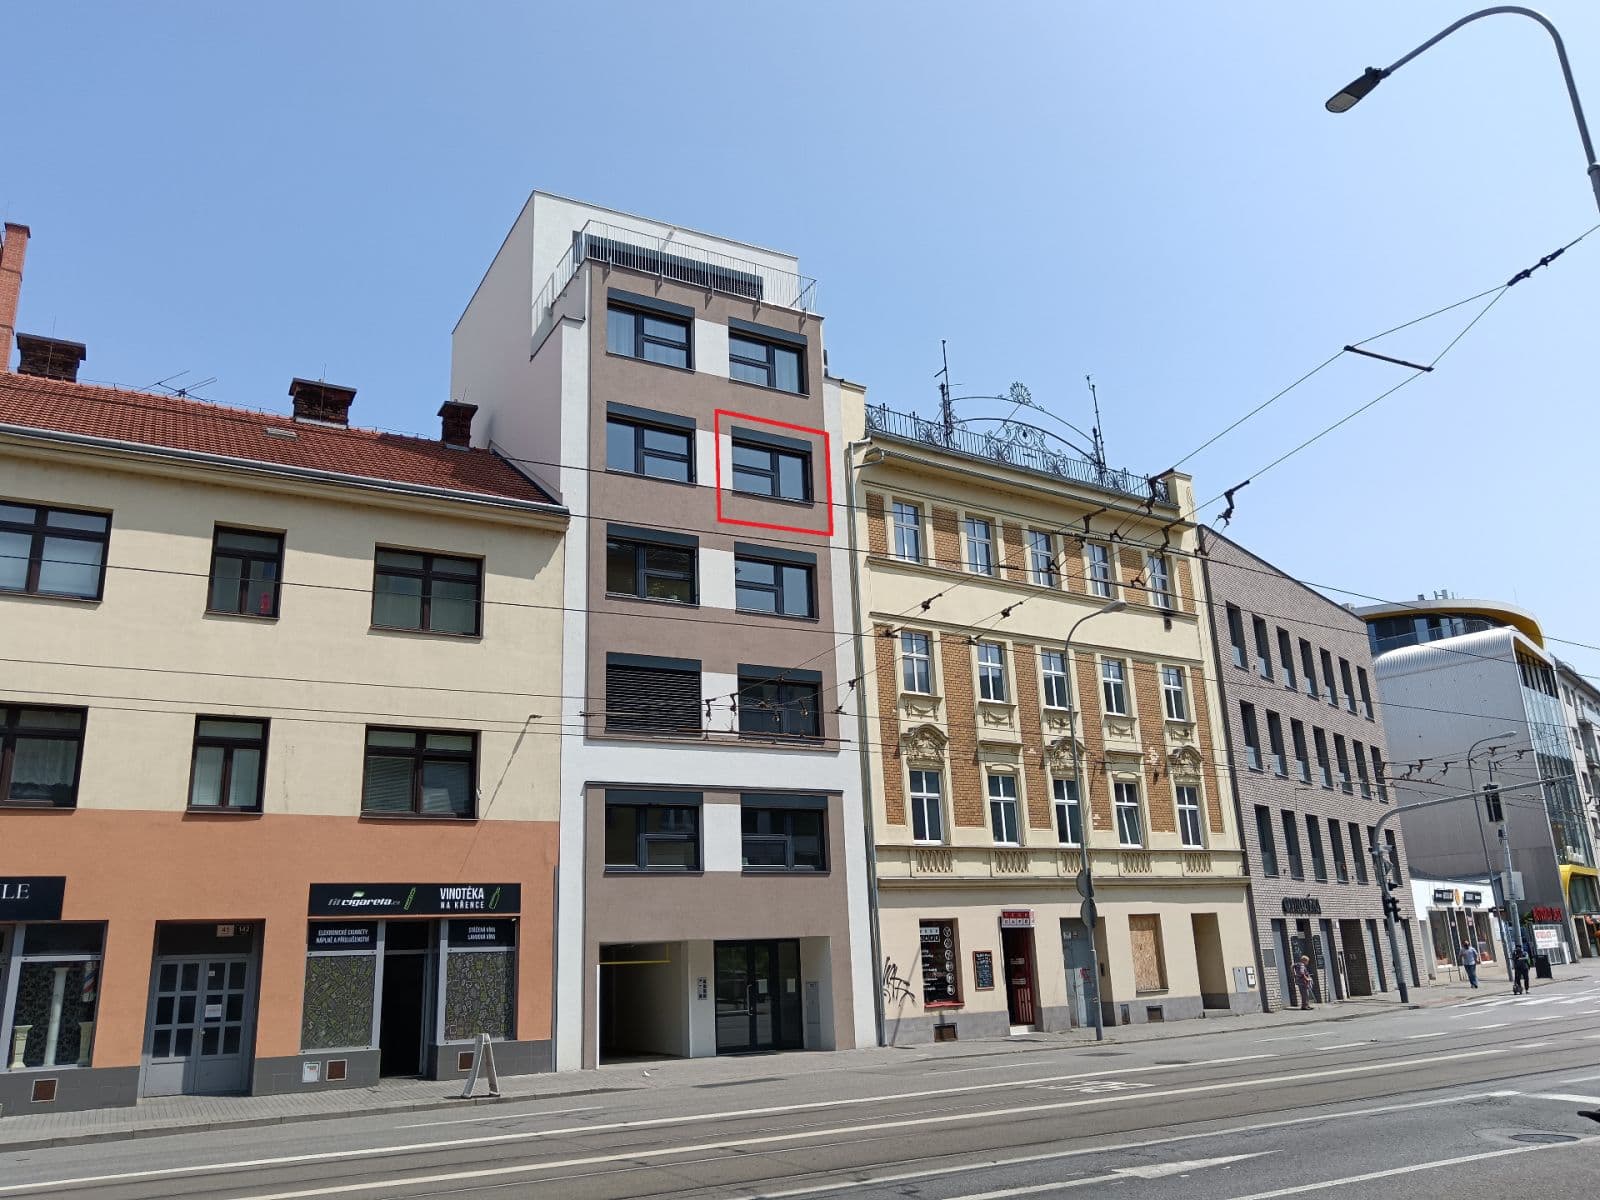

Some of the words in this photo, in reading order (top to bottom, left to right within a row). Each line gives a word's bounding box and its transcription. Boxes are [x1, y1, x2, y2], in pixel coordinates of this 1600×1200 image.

[439, 886, 485, 900] VINOTÉKA
[440, 901, 451, 909] NA
[454, 900, 485, 909] KŘENCE
